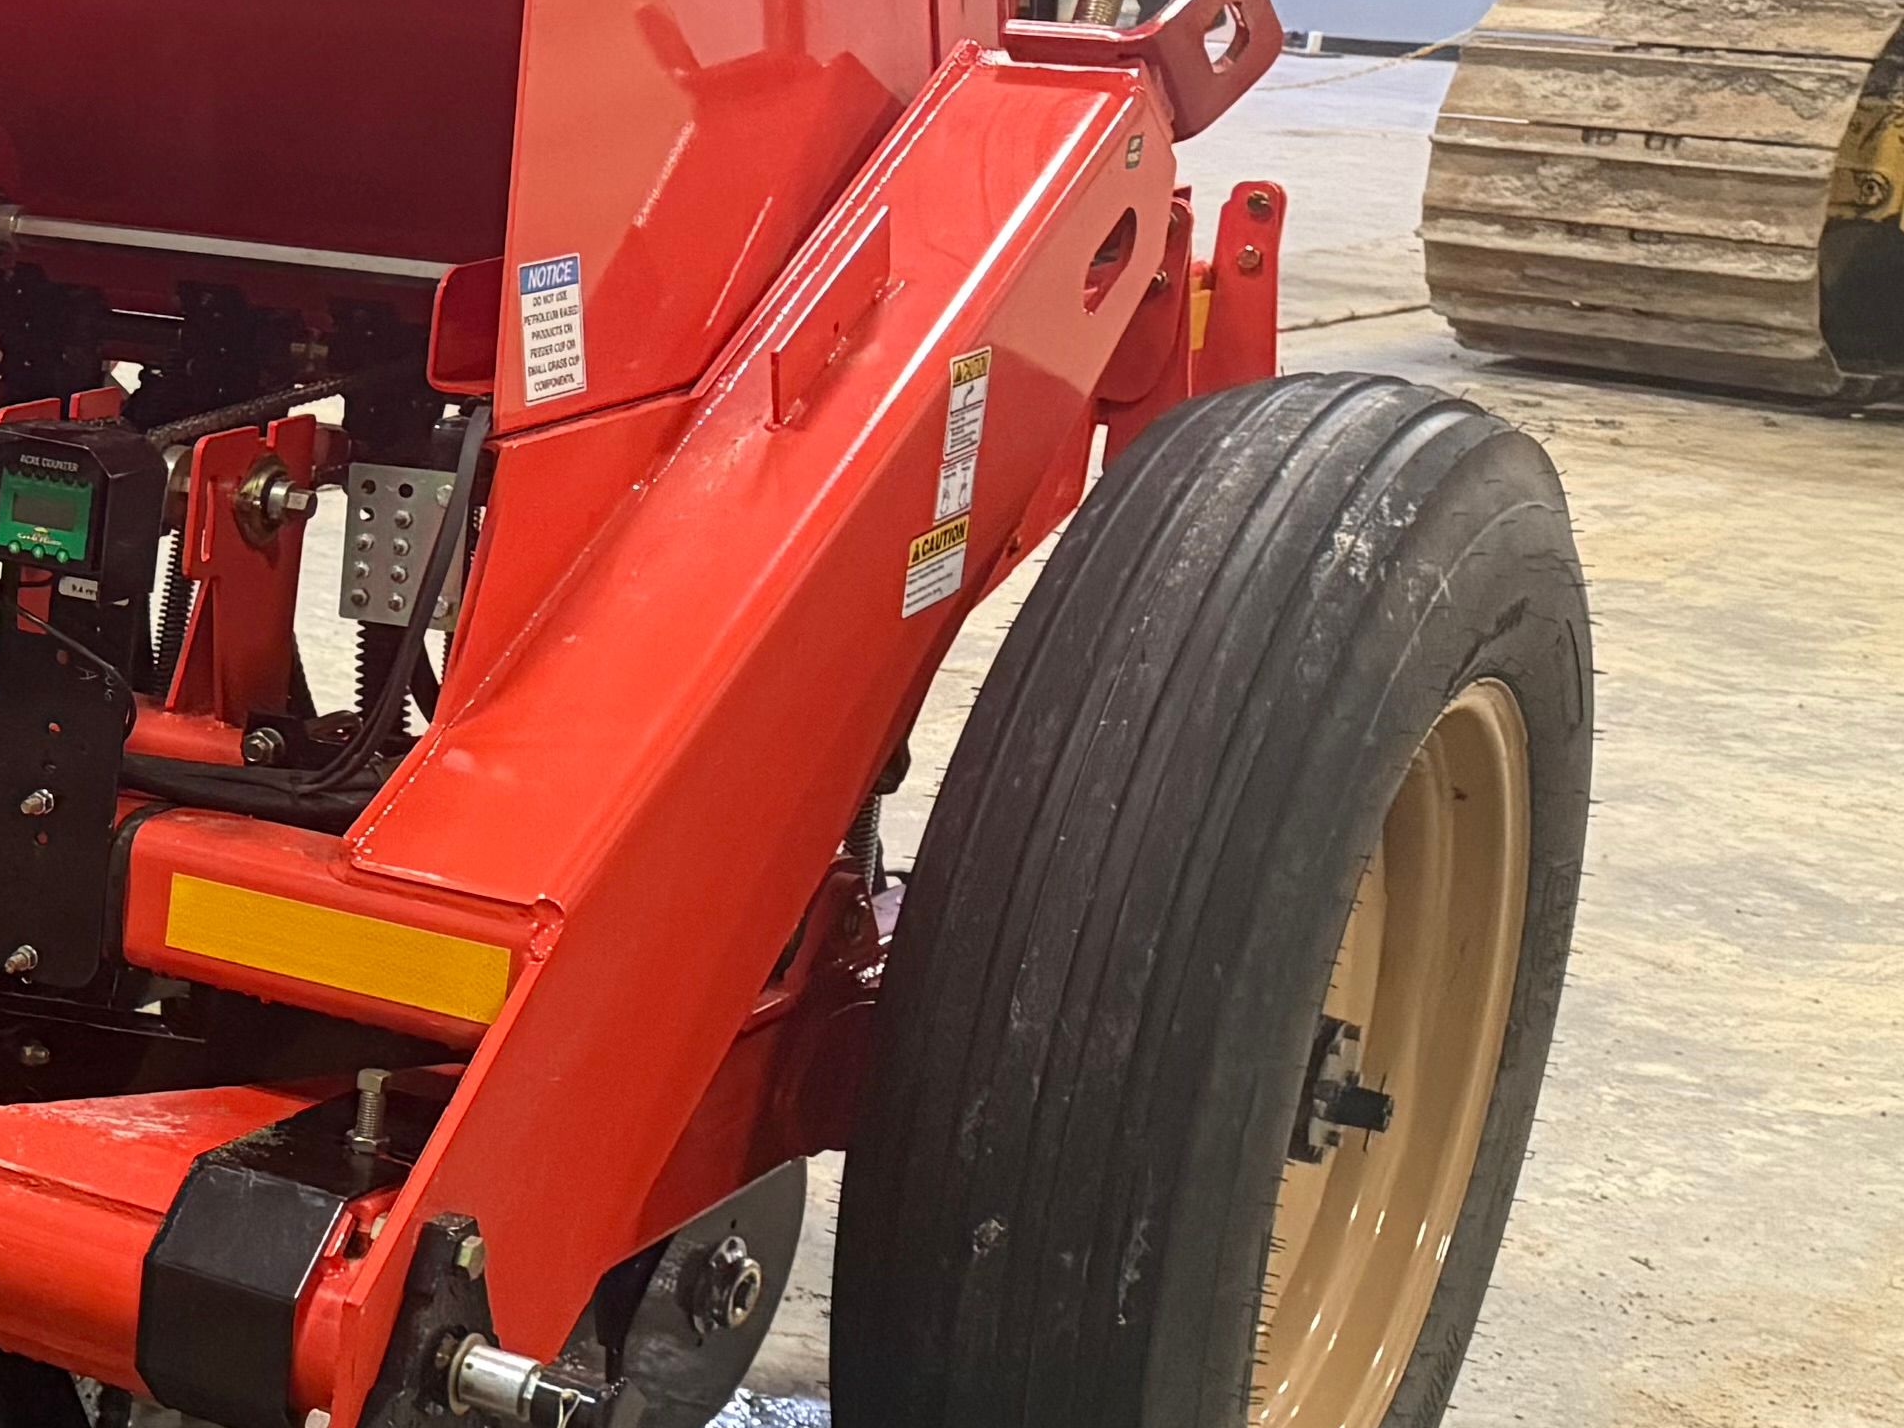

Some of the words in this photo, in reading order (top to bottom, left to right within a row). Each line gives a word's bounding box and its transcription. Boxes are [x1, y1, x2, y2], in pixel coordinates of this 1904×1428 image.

[527, 260, 574, 290] NOTICE
[531, 326, 563, 341] PRODUCTS
[41, 458, 79, 472] COUNTER
[921, 520, 967, 557] CAUTION
